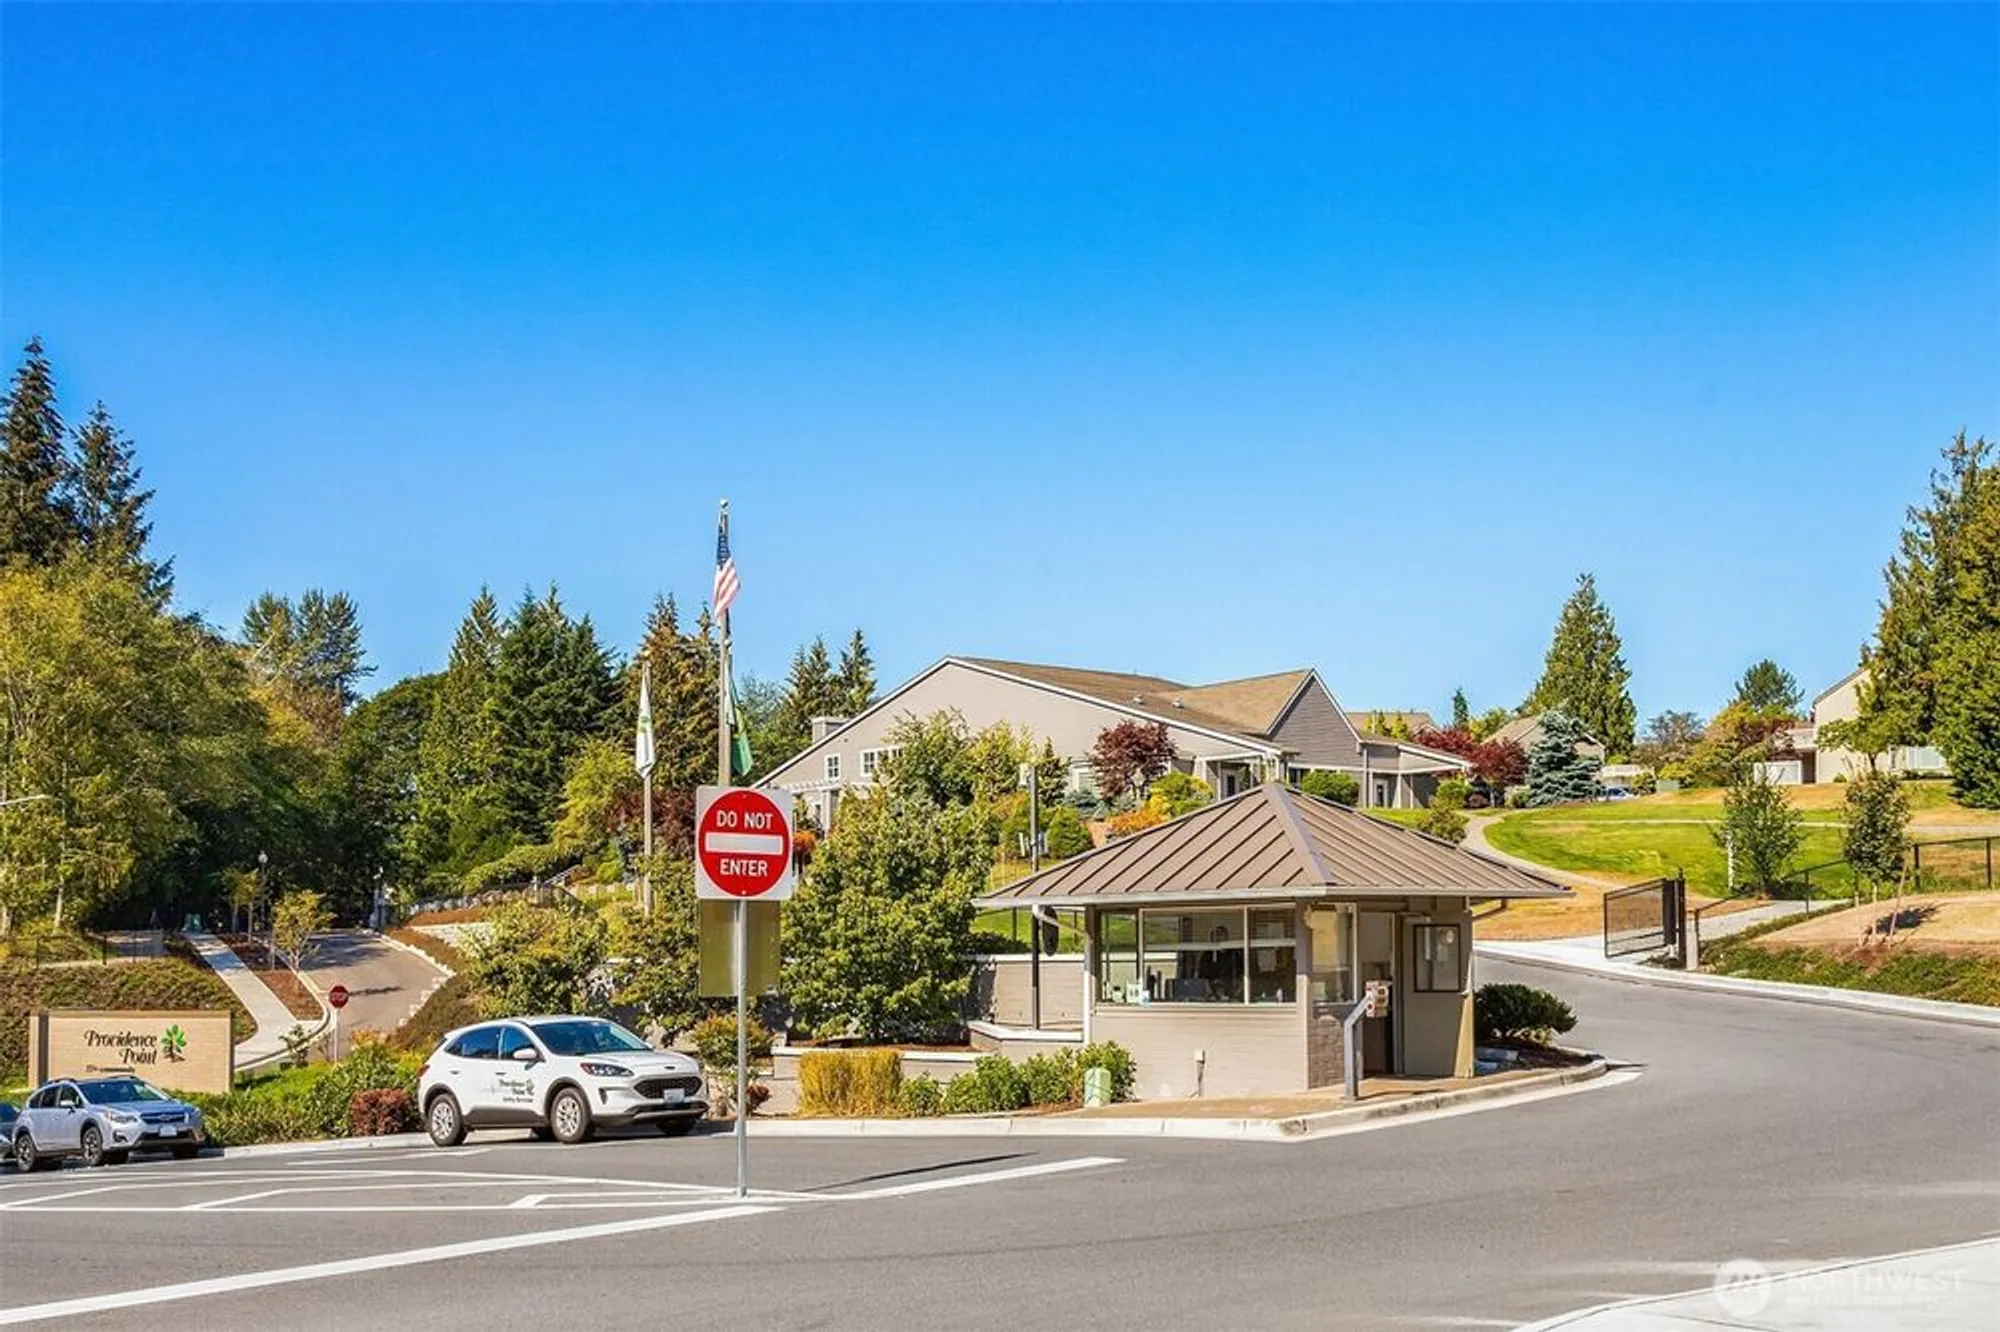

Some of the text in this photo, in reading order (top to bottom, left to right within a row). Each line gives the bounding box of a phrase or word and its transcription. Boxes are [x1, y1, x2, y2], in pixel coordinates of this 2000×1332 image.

[716, 810, 773, 829] DO NOT
[720, 858, 768, 877] ENTER
[118, 1048, 157, 1065] Point
